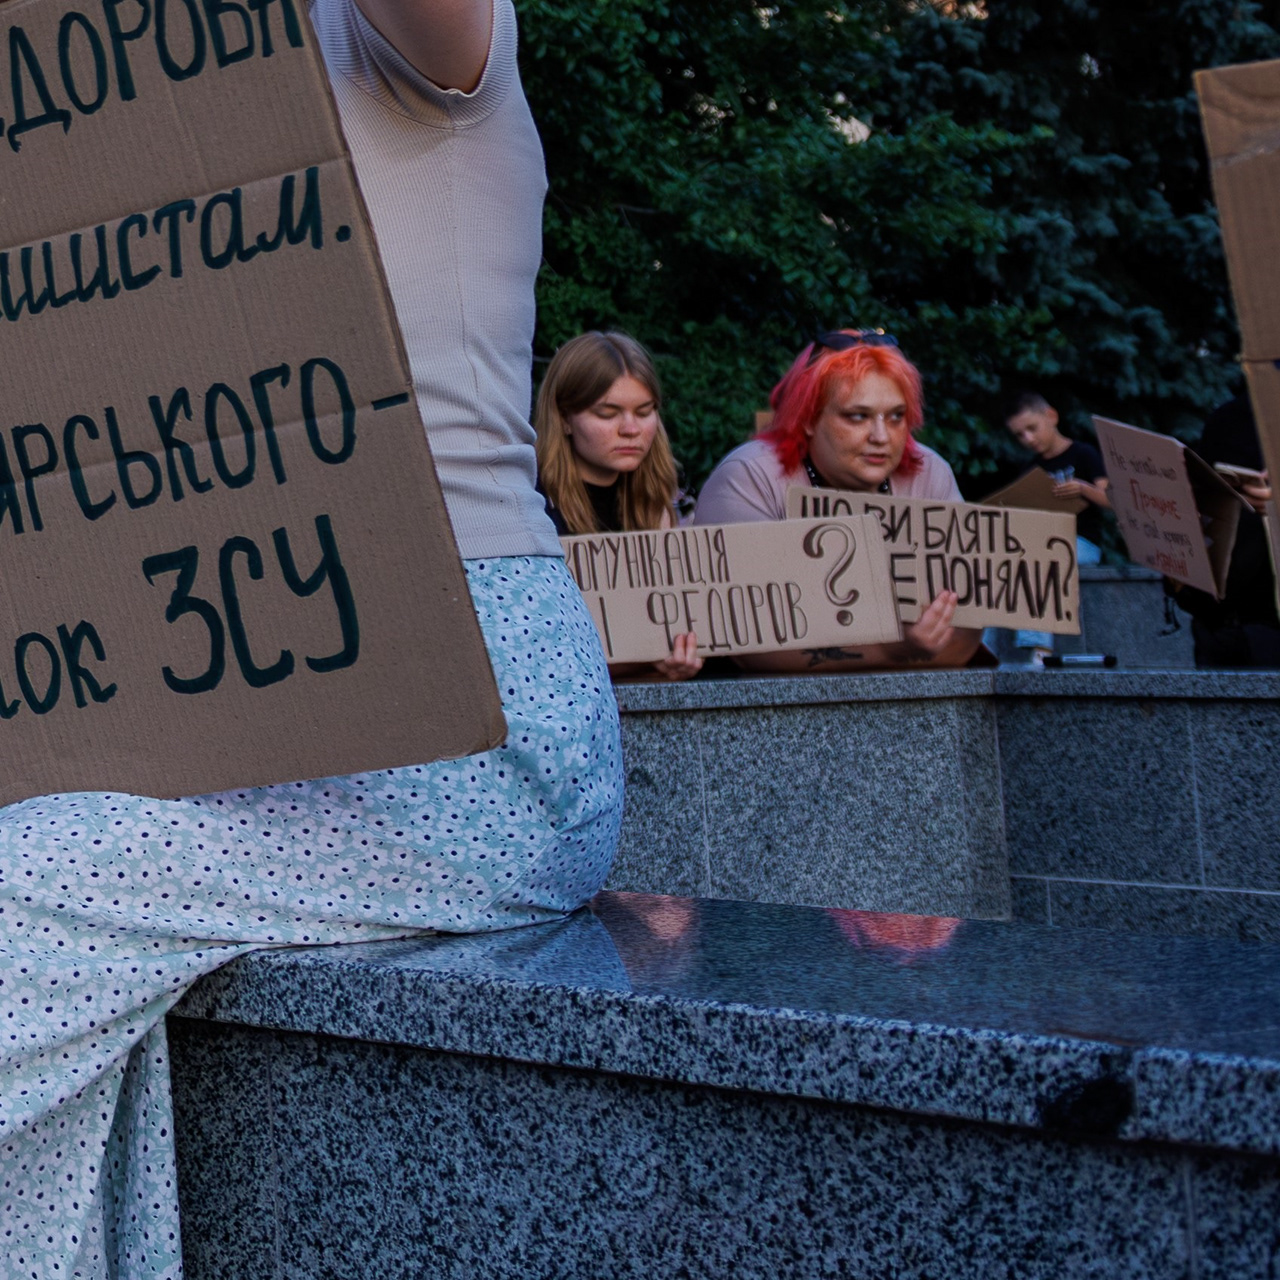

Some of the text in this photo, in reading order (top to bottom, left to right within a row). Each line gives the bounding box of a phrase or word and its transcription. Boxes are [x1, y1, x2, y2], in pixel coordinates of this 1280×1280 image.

[142, 514, 360, 695] ЗСУ
[647, 582, 808, 652] ФЕДОРОВ
[891, 536, 1075, 622] Е ПОНЯЛИ?
